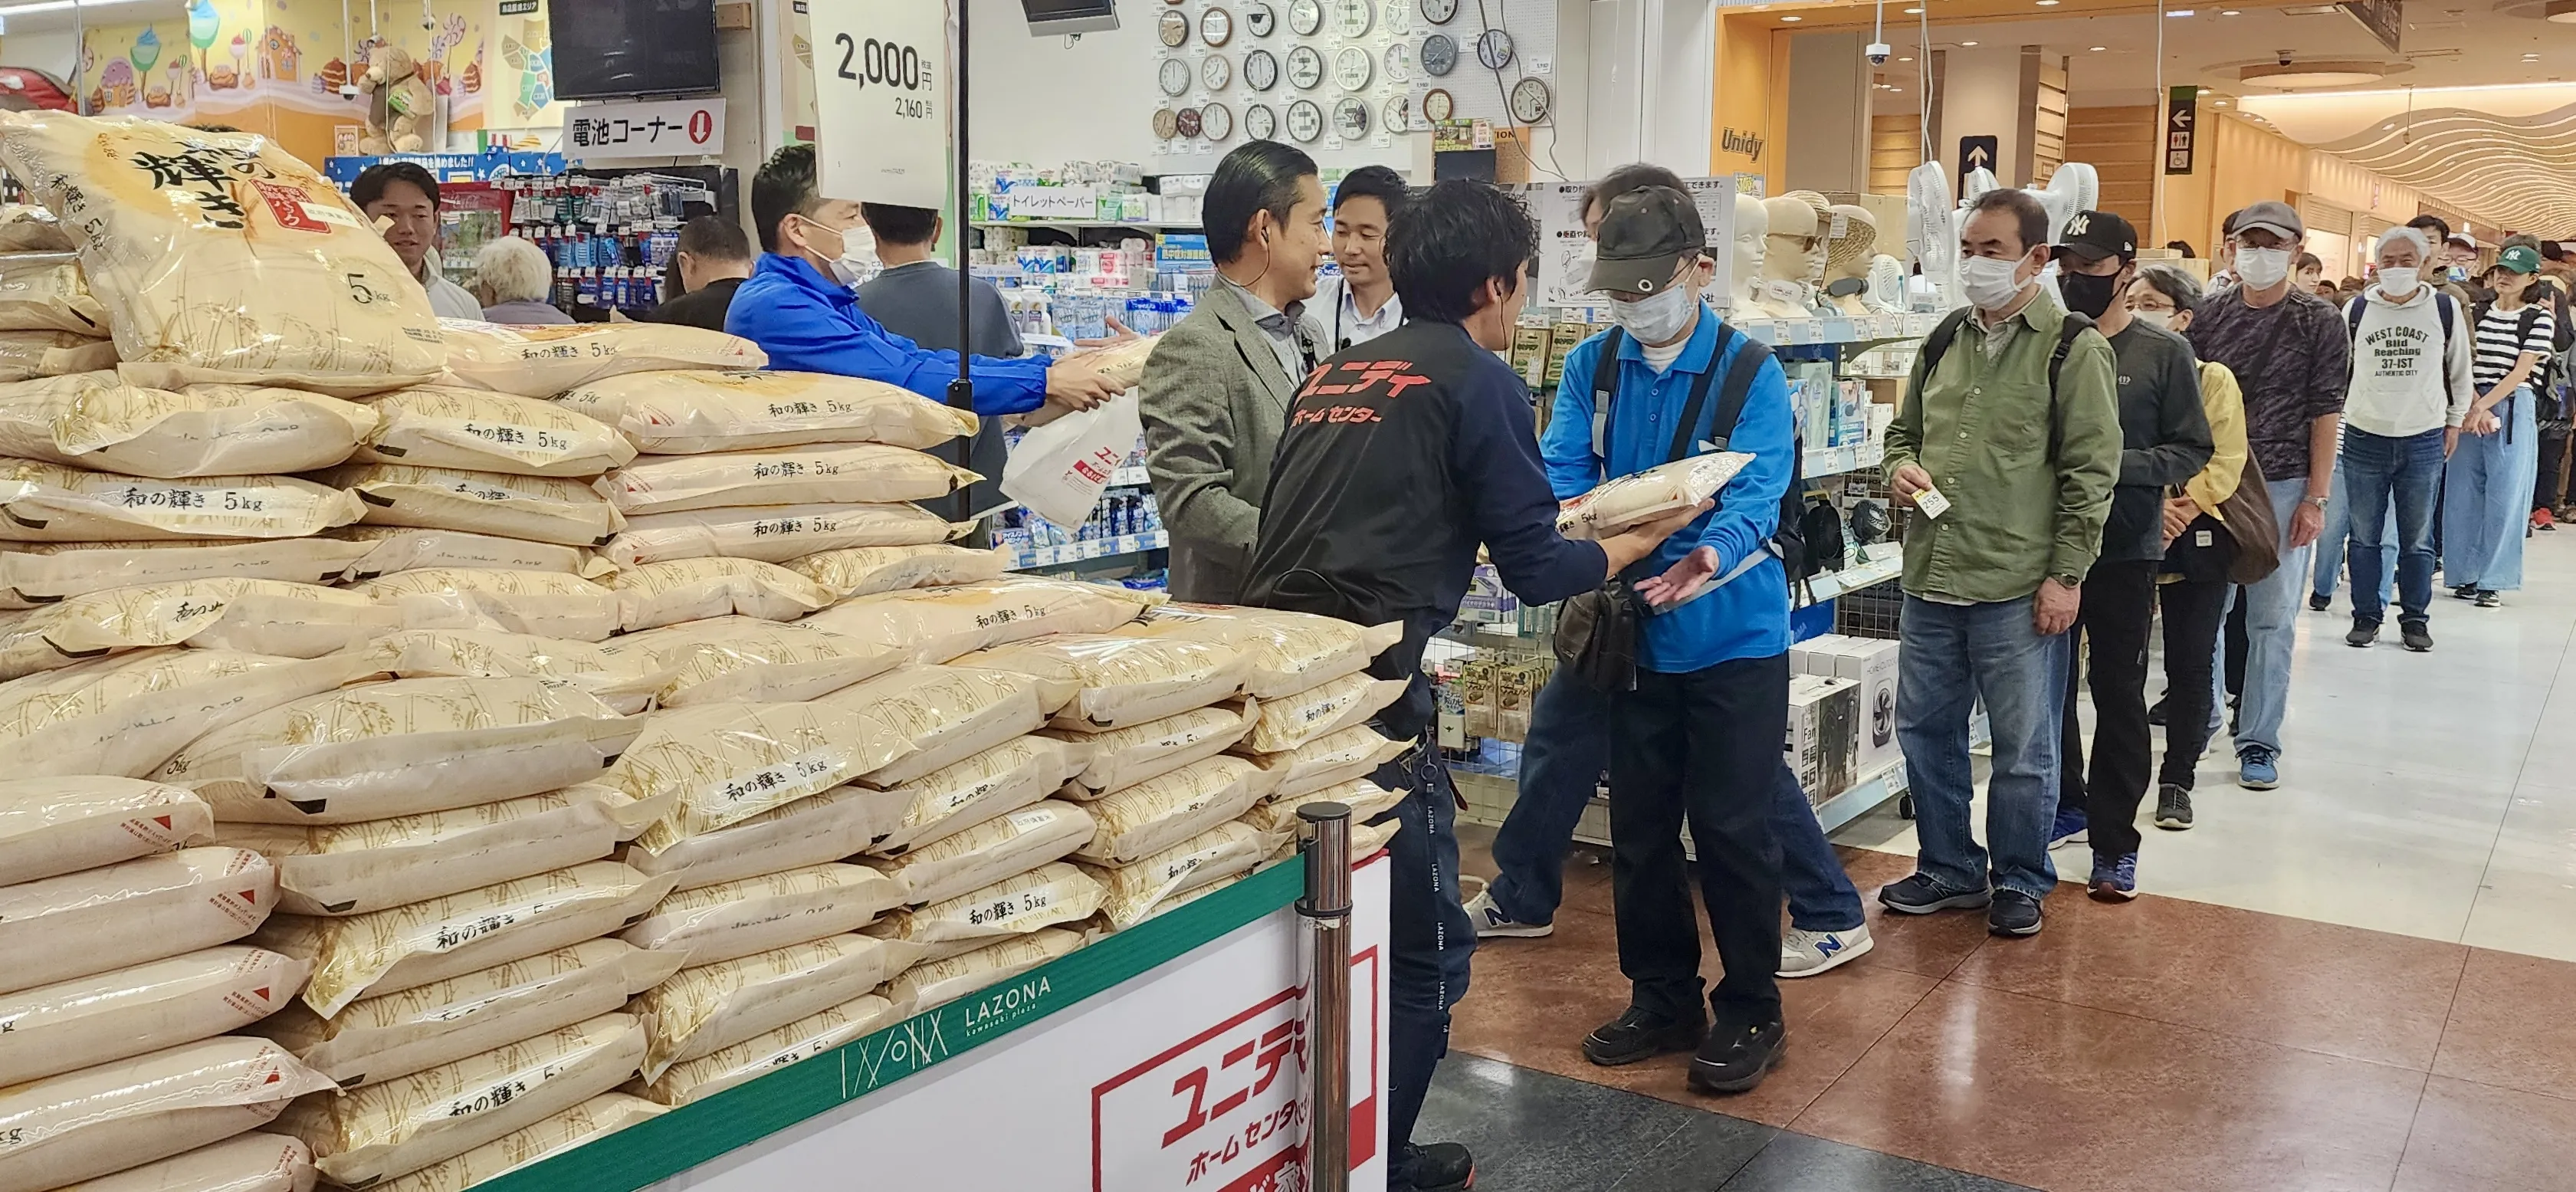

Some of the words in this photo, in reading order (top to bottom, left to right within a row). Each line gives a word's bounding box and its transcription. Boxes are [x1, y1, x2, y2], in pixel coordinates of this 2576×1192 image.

[835, 33, 918, 90] 2,000
[922, 72, 932, 90] 円
[895, 97, 922, 120] 2,160
[573, 117, 682, 146] 電池コーナー
[1721, 127, 1763, 163] Unidy
[1013, 194, 1092, 209] トイレットペーパー
[2365, 327, 2392, 346] WEST
[2395, 326, 2430, 343] COAST
[2374, 347, 2420, 356] Reaching
[1293, 360, 1432, 410] ユニディ
[768, 402, 818, 416] 和の輝き
[829, 400, 853, 414] 5kg
[464, 423, 524, 445] 和の輝き
[538, 432, 567, 451] 5kg
[753, 462, 804, 479] 和の輝き
[815, 461, 838, 476] 5kg
[123, 488, 205, 511] 和の輝き
[224, 492, 263, 512] 5kg
[1922, 494, 1940, 509] 255
[753, 520, 803, 537] 和の輝き
[813, 517, 837, 532] 5kg
[976, 609, 1017, 629] 和の輝き
[1024, 604, 1047, 619] 5kg
[1803, 727, 1816, 742] Fan
[166, 754, 191, 775] 5kg
[726, 771, 787, 803] 和の輝き
[795, 757, 829, 779] 5kg
[1427, 806, 1436, 834] LAZONA
[968, 902, 1015, 924] 和の輝き
[1023, 893, 1047, 911] 5kg
[966, 976, 1052, 1027] LAZONA
[966, 1014, 1009, 1037] kawasaki
[1012, 1003, 1037, 1021] plaza
[1161, 1017, 1308, 1150] ユニデ
[1186, 1099, 1306, 1187] ホームセンタ
